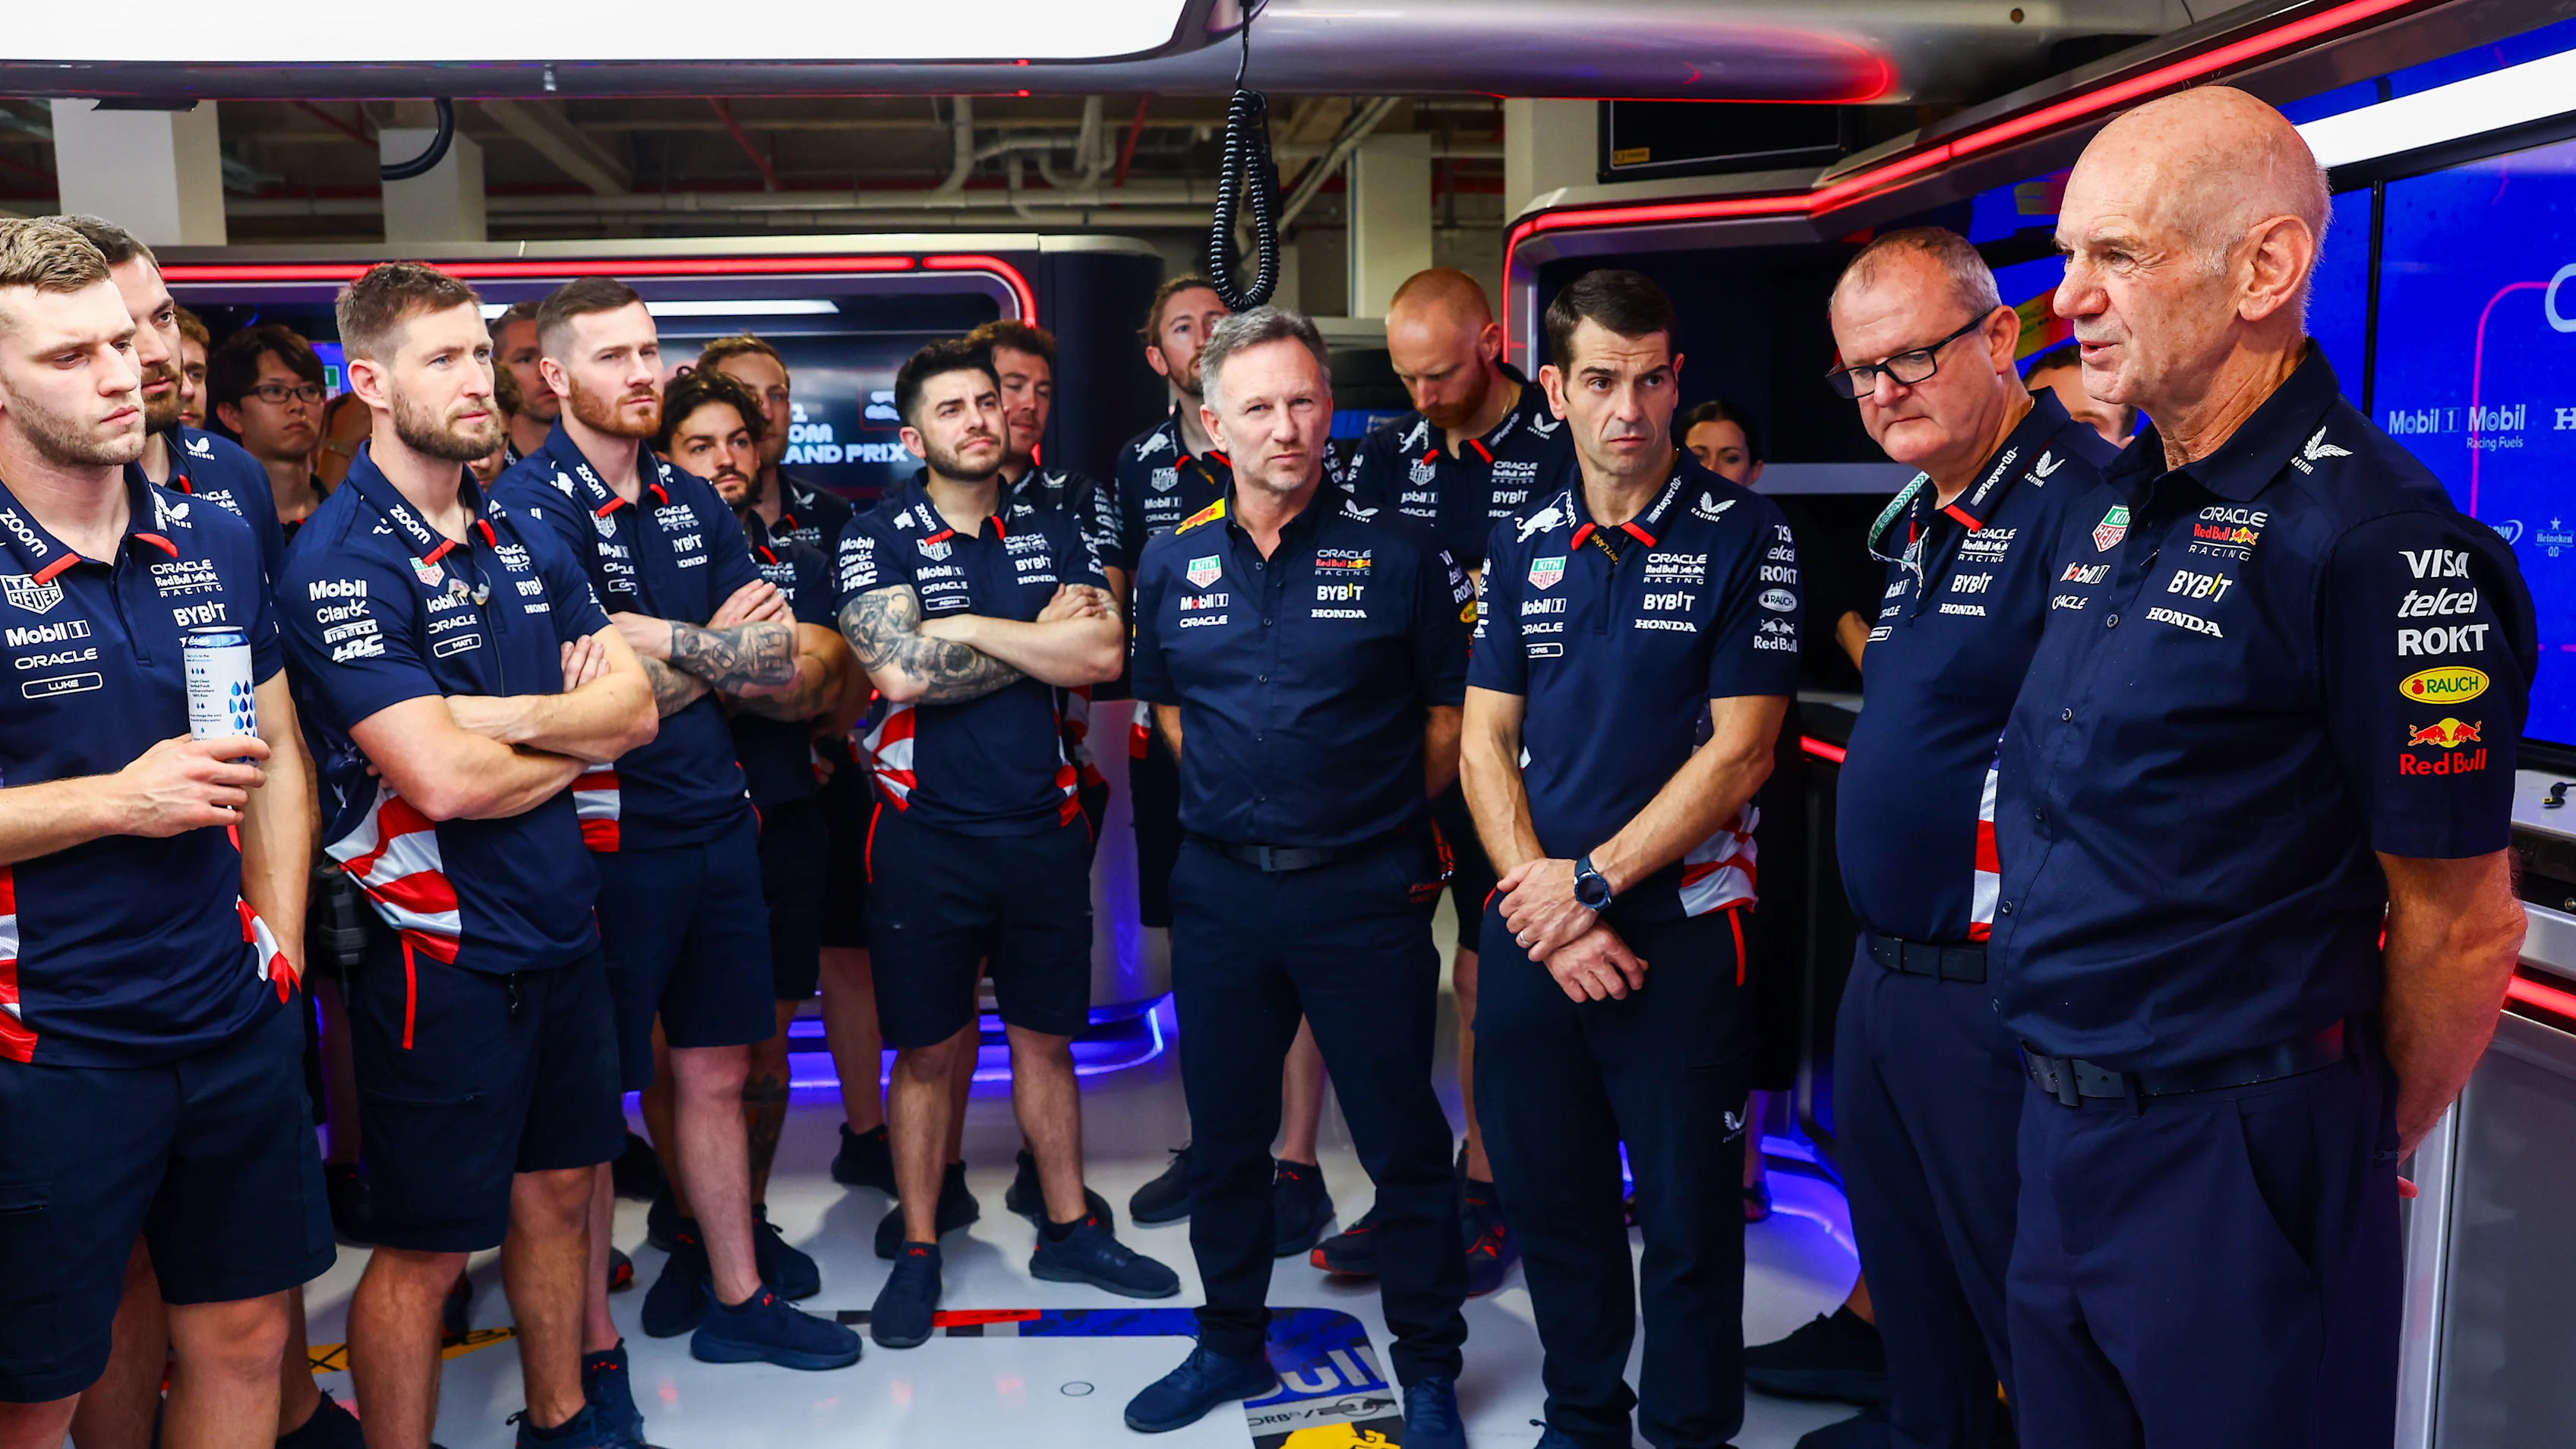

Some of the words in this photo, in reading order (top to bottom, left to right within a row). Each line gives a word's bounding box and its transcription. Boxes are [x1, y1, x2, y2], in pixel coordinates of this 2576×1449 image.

[2388, 408, 2439, 434] Mobil
[2468, 404, 2526, 432] Mobil
[2467, 437, 2496, 451] Racing
[2499, 436, 2523, 449] Fuels
[781, 444, 843, 464] AND
[845, 443, 908, 463] PRIX
[1493, 460, 1539, 471] ORACLE
[2290, 456, 2314, 475] ASTORE
[576, 462, 608, 500] zoom
[1978, 460, 2007, 495] Player
[1144, 497, 1171, 510] Mobil
[1492, 488, 1530, 504] BYBIT
[914, 502, 938, 532] zoom
[1145, 512, 1181, 522] ORACLE
[1488, 509, 1514, 518] HON
[1690, 507, 1721, 522] CASTORE
[1877, 502, 1902, 529] 2024
[2199, 507, 2268, 528] ORACLE
[0, 507, 48, 557] zoom
[390, 504, 431, 545] zoom
[1967, 528, 2017, 540] ORACLE
[2536, 533, 2573, 544] Heineken
[839, 536, 875, 553] Mobil
[1317, 548, 1372, 559] ORACLE
[1766, 545, 1795, 562] elcel
[2188, 545, 2252, 561] RACING
[150, 559, 213, 575] ORACLE
[1015, 554, 1052, 572] BYBIT
[1537, 560, 1561, 571] KITH
[1647, 553, 1708, 564] ORACLE
[1958, 554, 2005, 564] RACING
[2398, 548, 2470, 579] VISA
[842, 570, 879, 593] HRC
[917, 565, 952, 581] Mobil
[1017, 574, 1059, 585] HONDA
[1643, 576, 1704, 585] RACING
[1760, 564, 1798, 585] ROKT
[159, 585, 223, 598] RACING
[308, 579, 368, 601] Mobil
[515, 576, 544, 597] BYBI
[921, 581, 968, 595] ORACLE
[1317, 582, 1365, 601] BYBIT
[1950, 572, 1994, 594] BYBIT
[2167, 570, 2233, 602] BYBIT
[1179, 593, 1214, 611] Mobil
[1643, 590, 1696, 611] BYBIT
[1770, 594, 1794, 607] RAUCH
[2052, 595, 2088, 610] OACLE
[2398, 587, 2477, 617] telcel
[172, 601, 226, 627] BYBIT
[316, 598, 370, 623] Claro
[1311, 608, 1368, 618] HONDA
[1939, 603, 1986, 617] HONDA
[428, 614, 478, 634] ORACLE
[1179, 614, 1228, 628] ORACLE
[1634, 619, 1697, 633] HONDA
[2145, 607, 2224, 638] HONDA
[5, 623, 68, 647] Mobil
[324, 619, 378, 644] PIRELLI
[2398, 623, 2489, 656] ROKT
[332, 633, 384, 661] HRC
[452, 638, 473, 649] MATT
[1754, 636, 1779, 651] Red
[1779, 638, 1798, 653] Bull
[14, 648, 98, 670] ORACLE
[48, 678, 79, 690] LUKE
[2426, 675, 2479, 694] RAUCH
[2400, 753, 2450, 775] Red
[2452, 749, 2486, 773] Bull
[1279, 1345, 1388, 1394] ull
